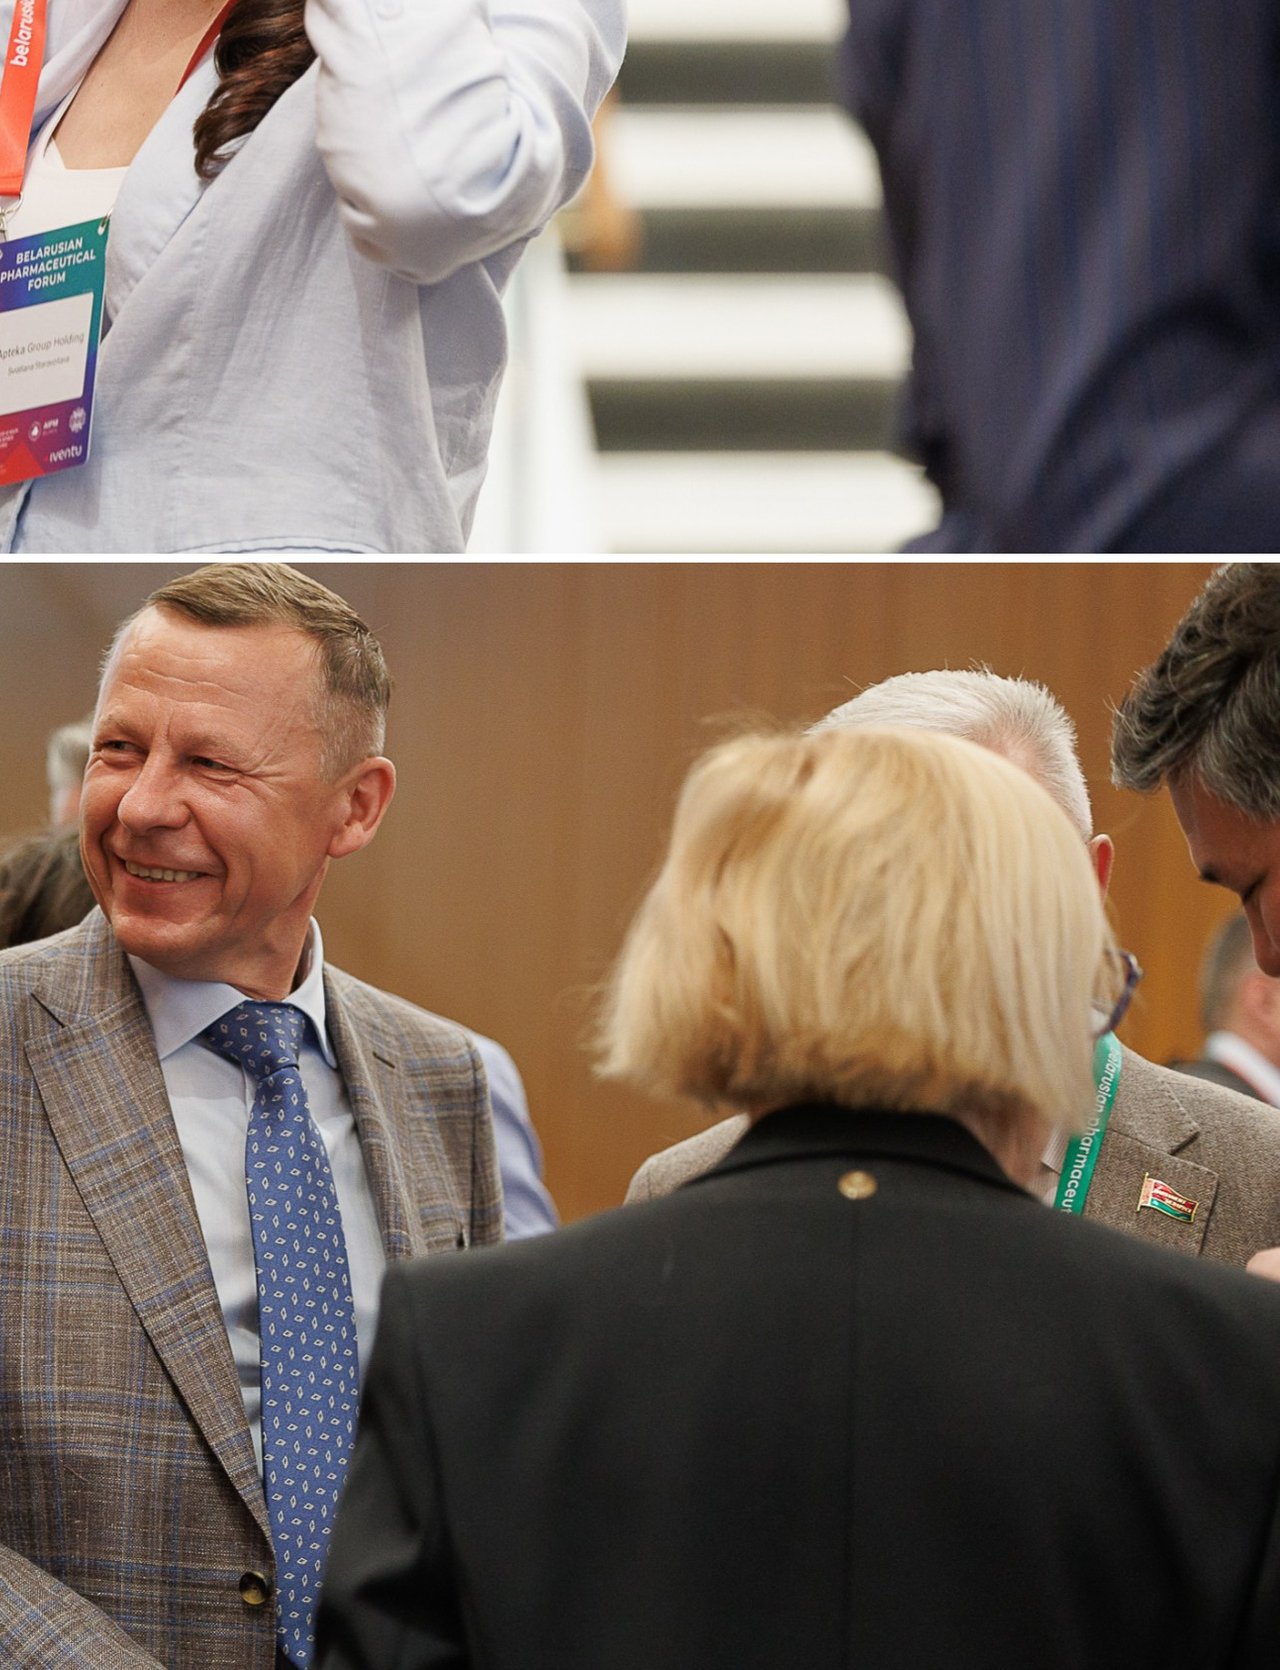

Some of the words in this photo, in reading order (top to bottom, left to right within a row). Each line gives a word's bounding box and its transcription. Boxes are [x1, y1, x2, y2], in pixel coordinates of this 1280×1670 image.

[16, 237, 83, 264] BELARUSIAN
[0, 248, 96, 283] PHARMACEUTICAL
[27, 271, 66, 292] FORUM
[27, 341, 52, 354] Group
[53, 333, 84, 347] Holding
